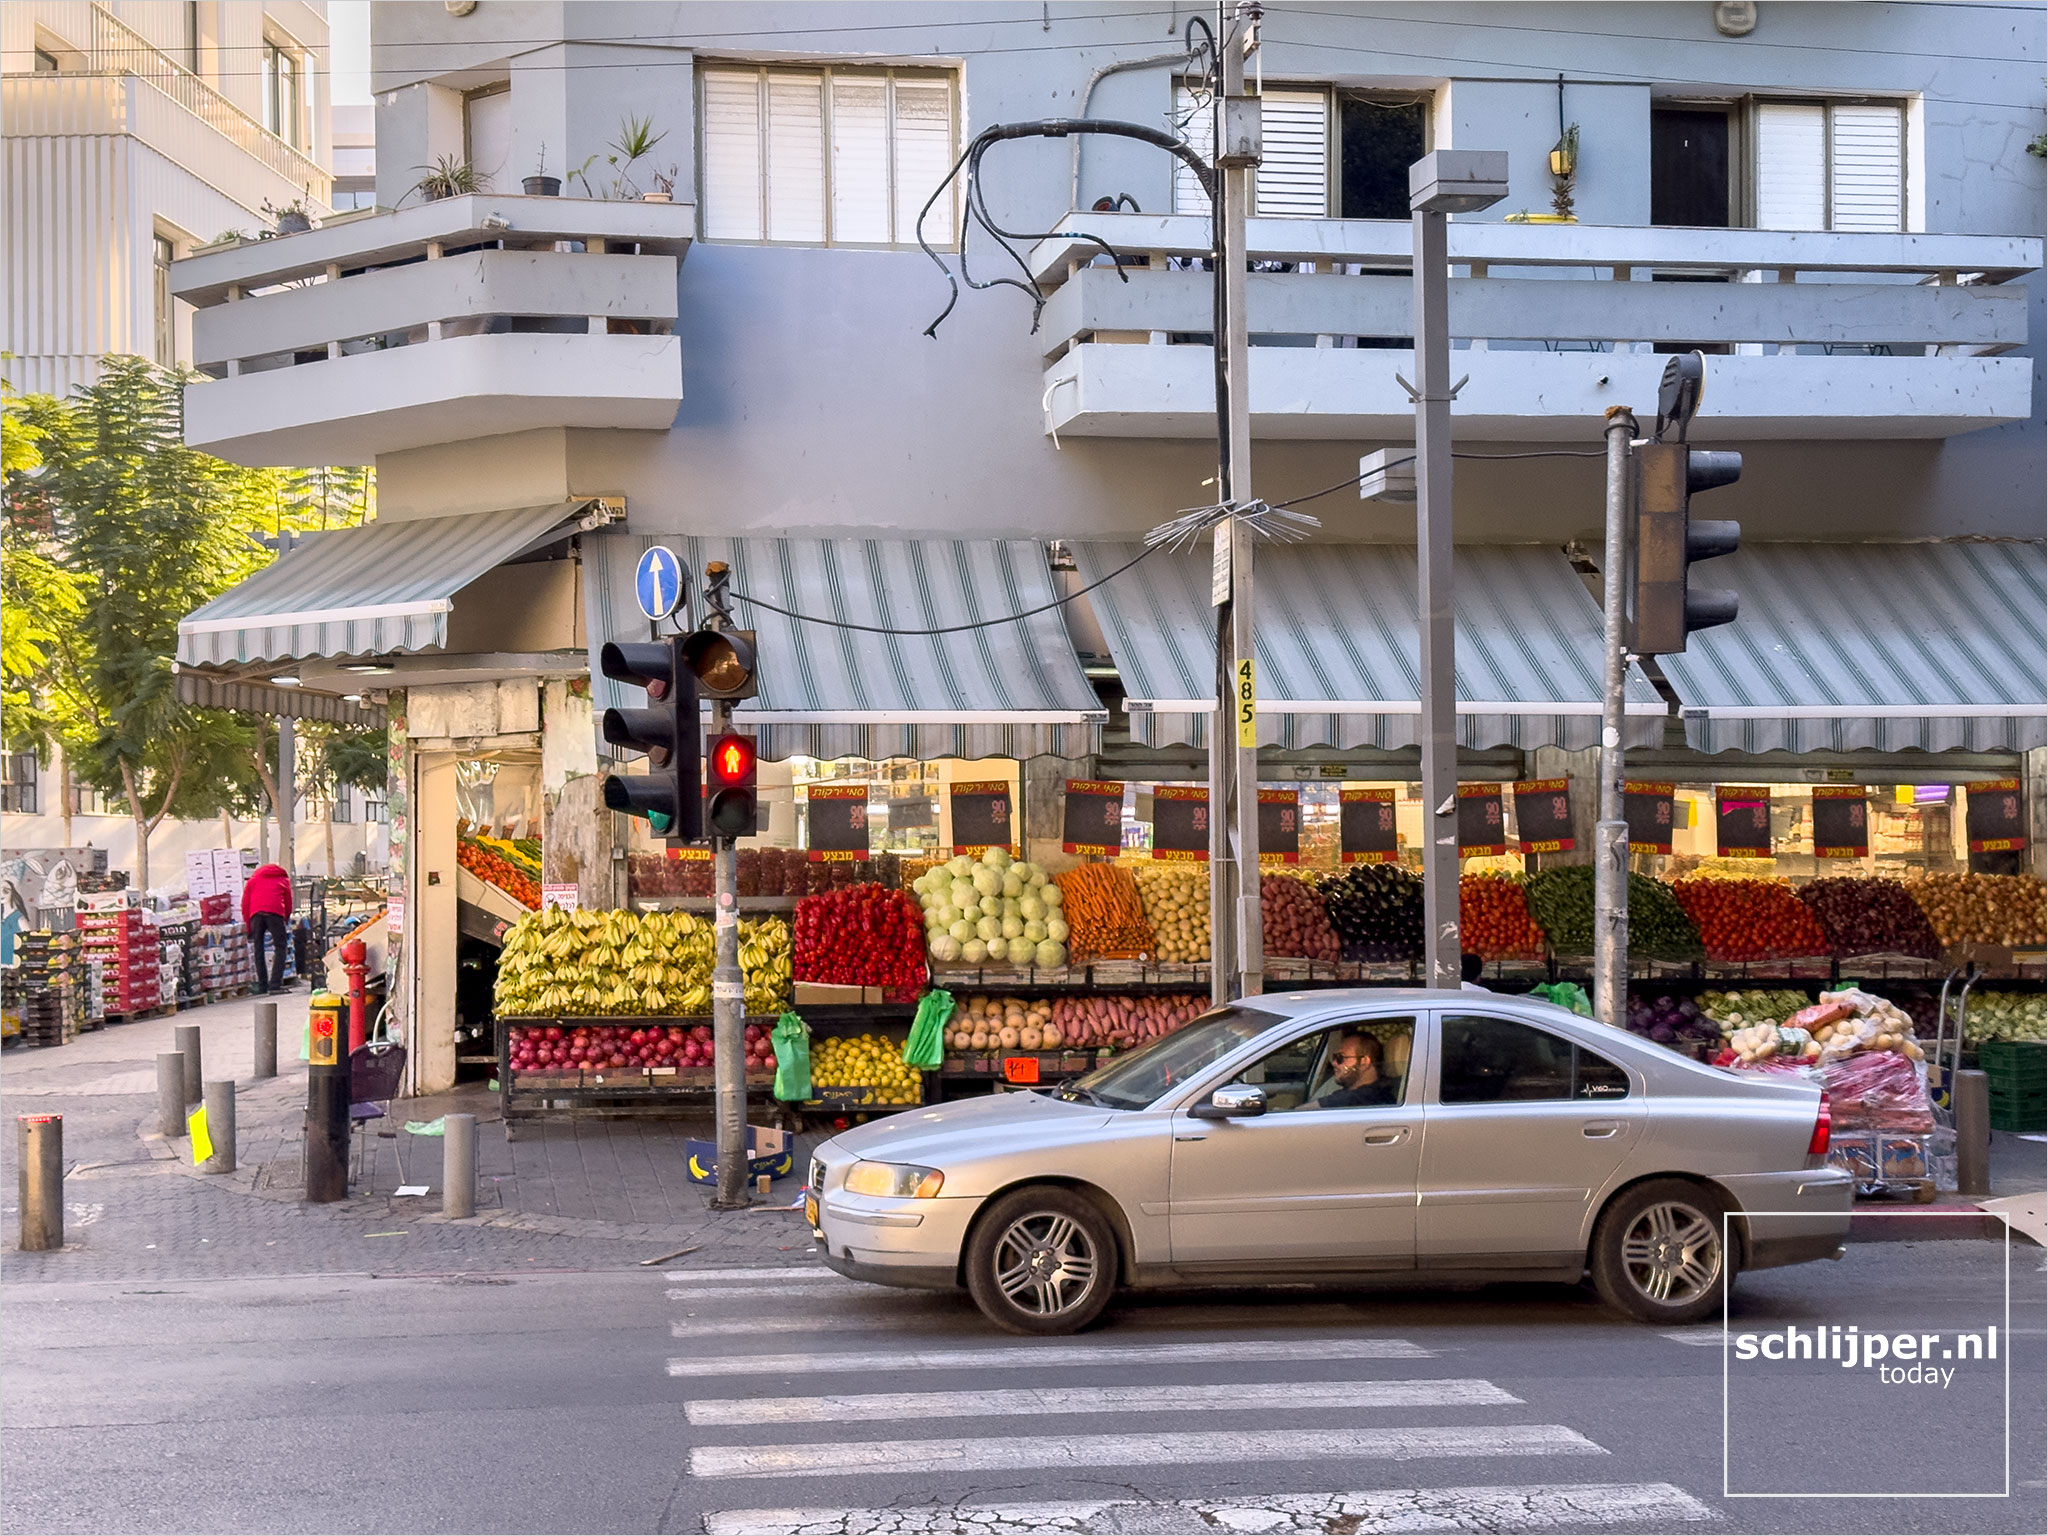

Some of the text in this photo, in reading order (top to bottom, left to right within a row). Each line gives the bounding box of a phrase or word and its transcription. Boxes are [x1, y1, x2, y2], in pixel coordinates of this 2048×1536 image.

[1239, 660, 1254, 724] 485
[1075, 844, 1106, 855] מבצע
[1462, 845, 1493, 857] מבצע
[1530, 840, 1560, 853] מבצע
[1628, 843, 1658, 853] מבצע
[1982, 839, 2011, 851] מבצע
[678, 849, 711, 861] מבצע
[821, 850, 854, 862] מבצע
[1165, 849, 1195, 861] מבצע
[1353, 851, 1384, 863] מבצע
[1728, 847, 1757, 858] מבצע
[1825, 847, 1854, 858] מבצע
